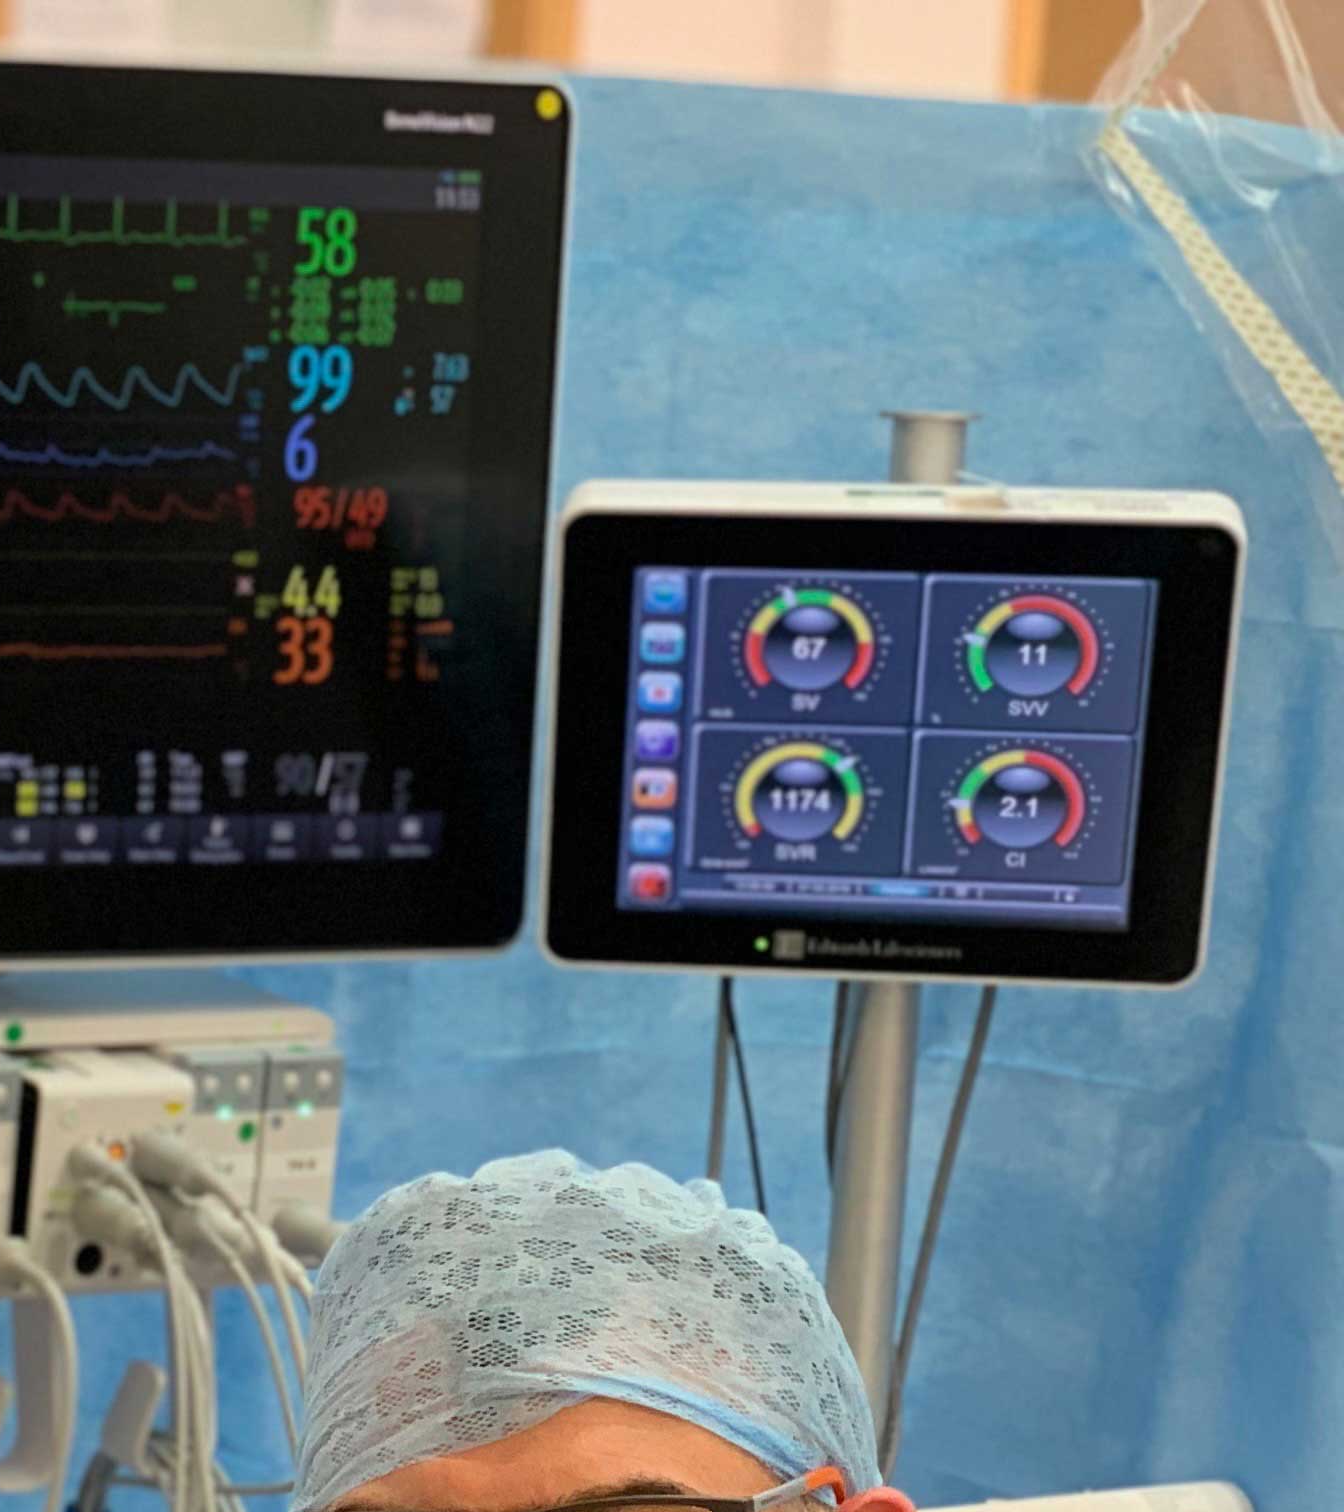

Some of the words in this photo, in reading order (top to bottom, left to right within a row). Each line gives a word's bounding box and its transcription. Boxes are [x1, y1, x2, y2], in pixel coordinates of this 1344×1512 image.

[296, 207, 358, 278] 58
[288, 344, 354, 413] 99
[284, 413, 318, 482] 6
[281, 564, 342, 618] 4.4
[272, 616, 334, 686] 33
[791, 635, 829, 661] 67
[1019, 643, 1048, 666] 11
[790, 693, 822, 712] SV
[1007, 700, 1050, 718] SVV
[769, 788, 832, 812] 1174
[999, 796, 1039, 819] 2.1
[774, 843, 817, 862] SVR
[1005, 852, 1027, 868] CI
